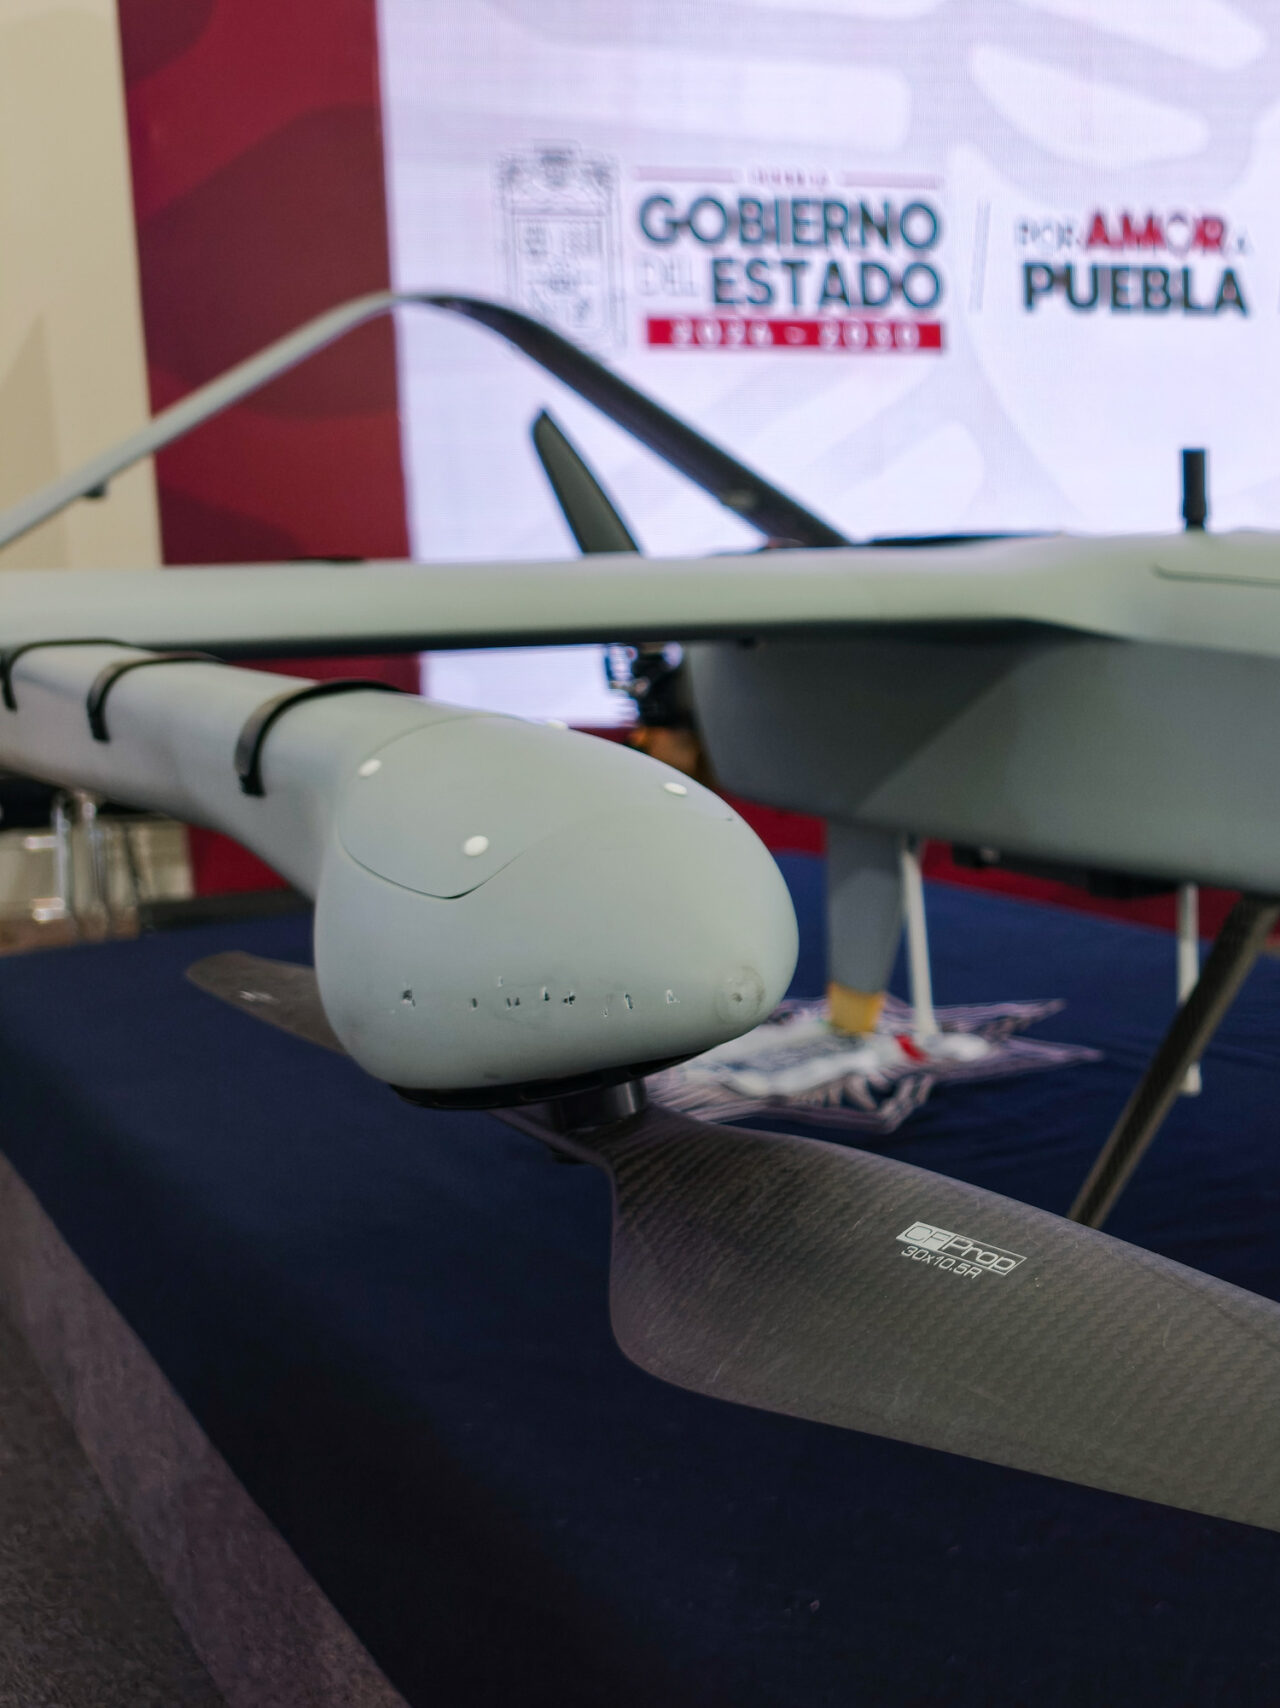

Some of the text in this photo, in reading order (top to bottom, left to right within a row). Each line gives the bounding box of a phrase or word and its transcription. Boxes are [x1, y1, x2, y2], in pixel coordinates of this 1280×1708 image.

[638, 193, 942, 251] GOBIERNO
[1087, 211, 1227, 253] AMOR
[712, 257, 943, 308] ESTADO
[1022, 262, 1248, 316] PUEBLA
[901, 1245, 983, 1279] 30x10.5R
